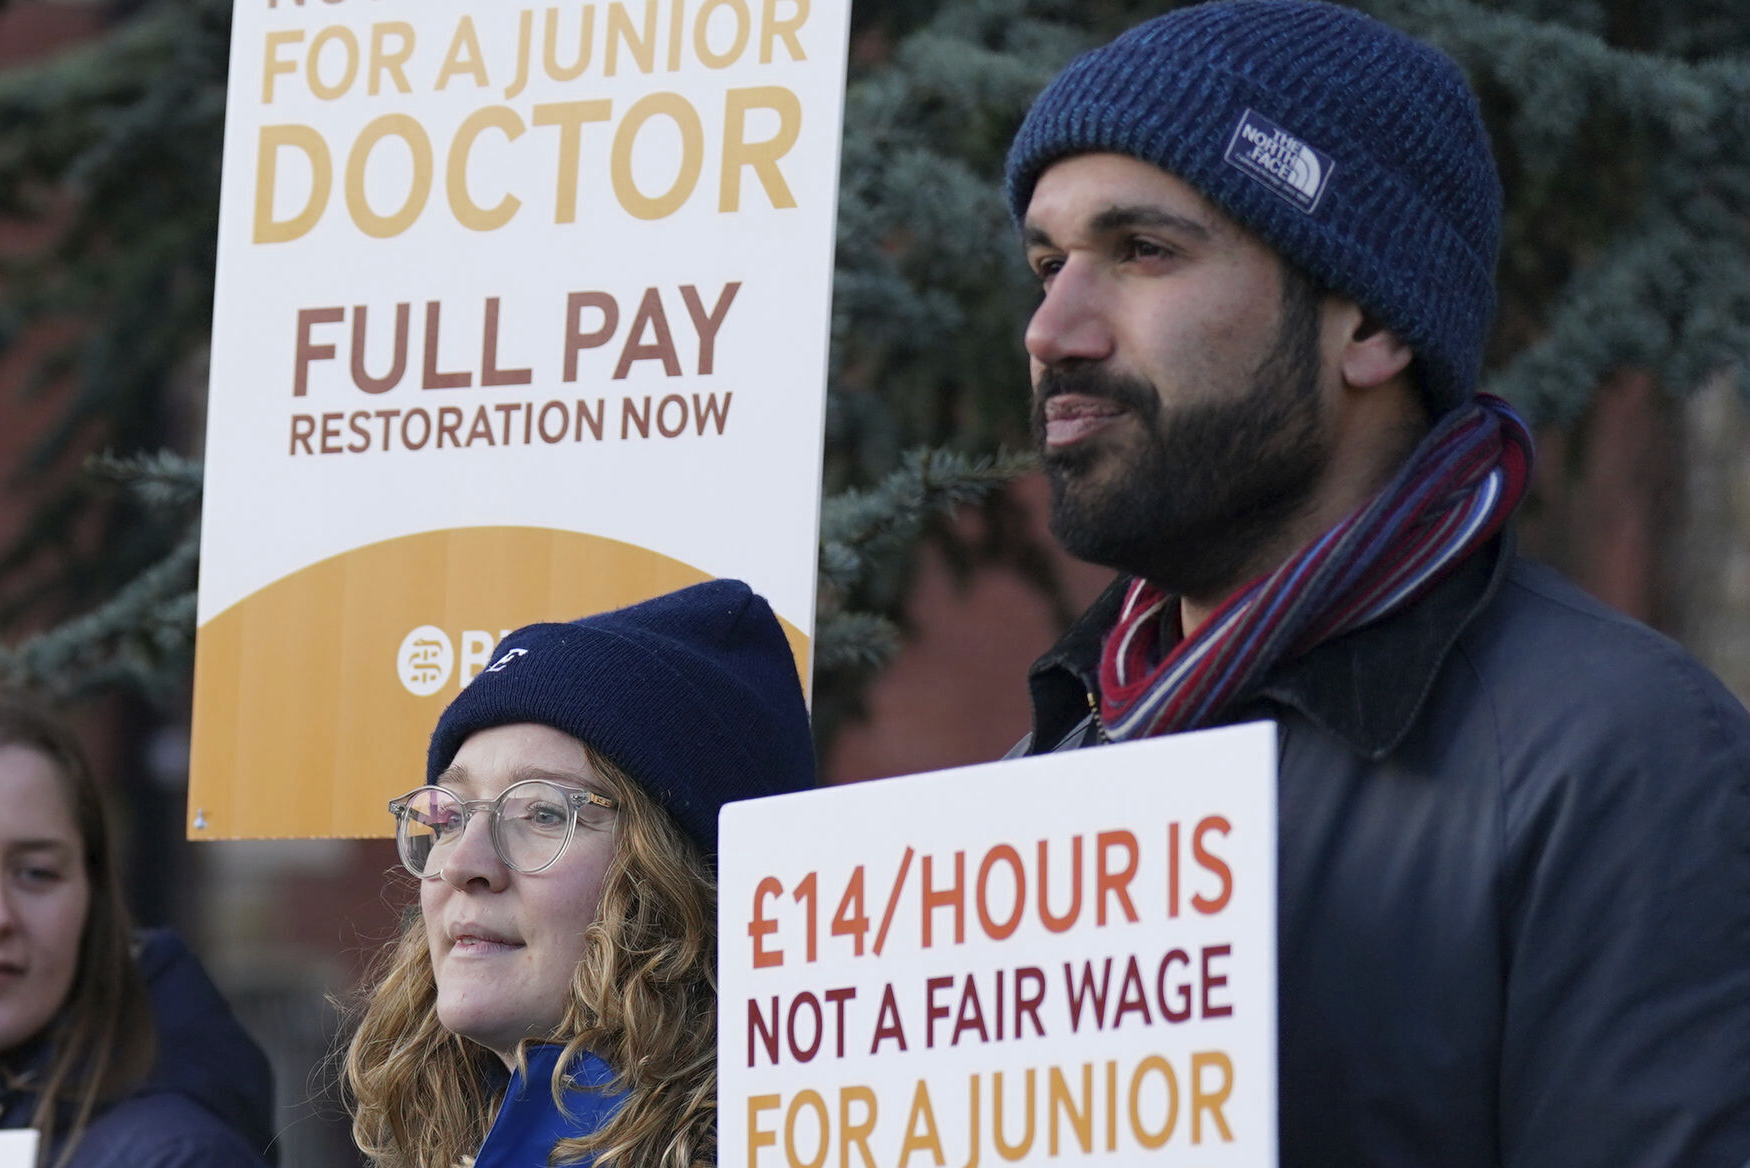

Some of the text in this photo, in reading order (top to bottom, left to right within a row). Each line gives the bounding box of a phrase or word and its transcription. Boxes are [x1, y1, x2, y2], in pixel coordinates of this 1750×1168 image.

[261, 0, 809, 105] FOR A JUNIOR
[252, 85, 803, 245] DOCTOR
[1242, 123, 1298, 169] NORTH
[1251, 146, 1291, 181] FACE
[1273, 128, 1302, 150] THE
[292, 281, 744, 398] FULL PAY
[288, 392, 733, 456] RESTORATION NOW
[748, 814, 1235, 970] £14/HOUR IS
[748, 943, 1233, 1068] NOT A FAIR WAGE
